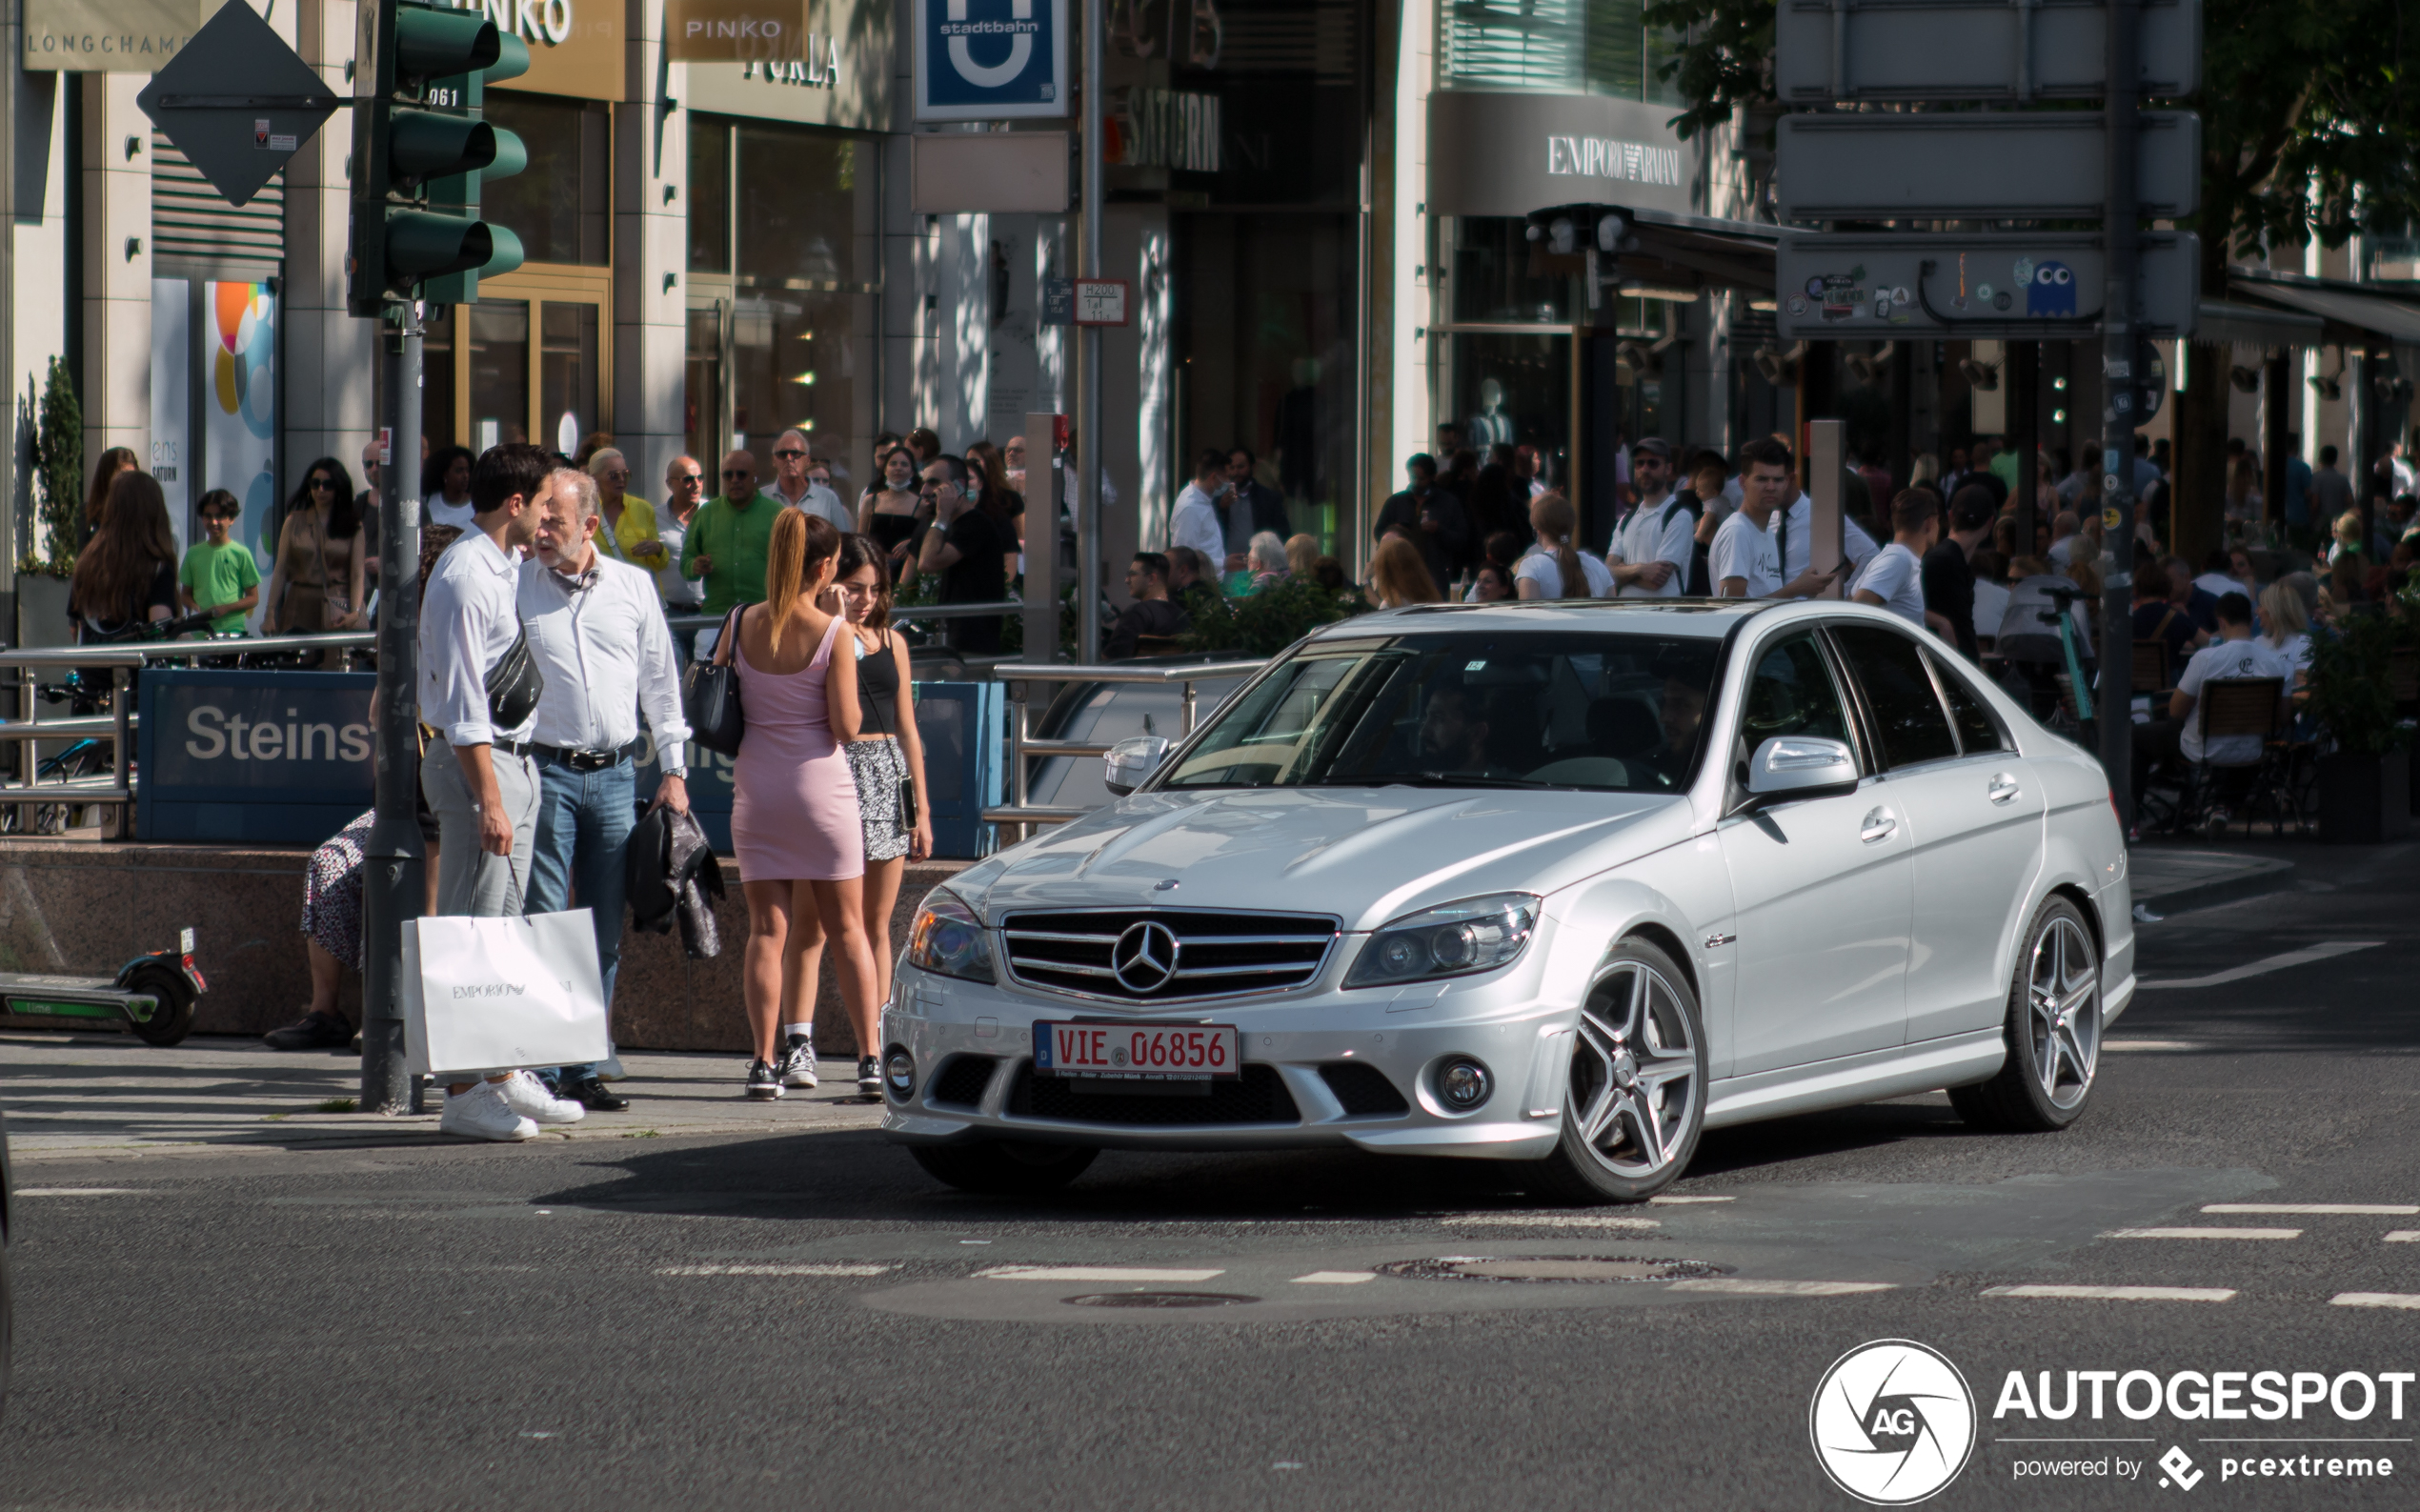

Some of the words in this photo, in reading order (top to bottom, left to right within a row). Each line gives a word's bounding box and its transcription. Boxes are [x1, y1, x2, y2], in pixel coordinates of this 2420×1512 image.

[686, 20, 781, 39] PINKO
[940, 20, 1039, 34] stadtbahn
[429, 88, 457, 107] 061
[1547, 136, 1628, 180] EMPORIO
[1636, 145, 1679, 186] ARMANI
[1086, 284, 1115, 295] H200
[152, 466, 177, 482] SATURN
[186, 705, 377, 761] Steins
[453, 983, 510, 998] EMPORIO
[1040, 1050, 1047, 1060] D
[1058, 1029, 1109, 1065] VIE
[1131, 1032, 1225, 1067] 06856
